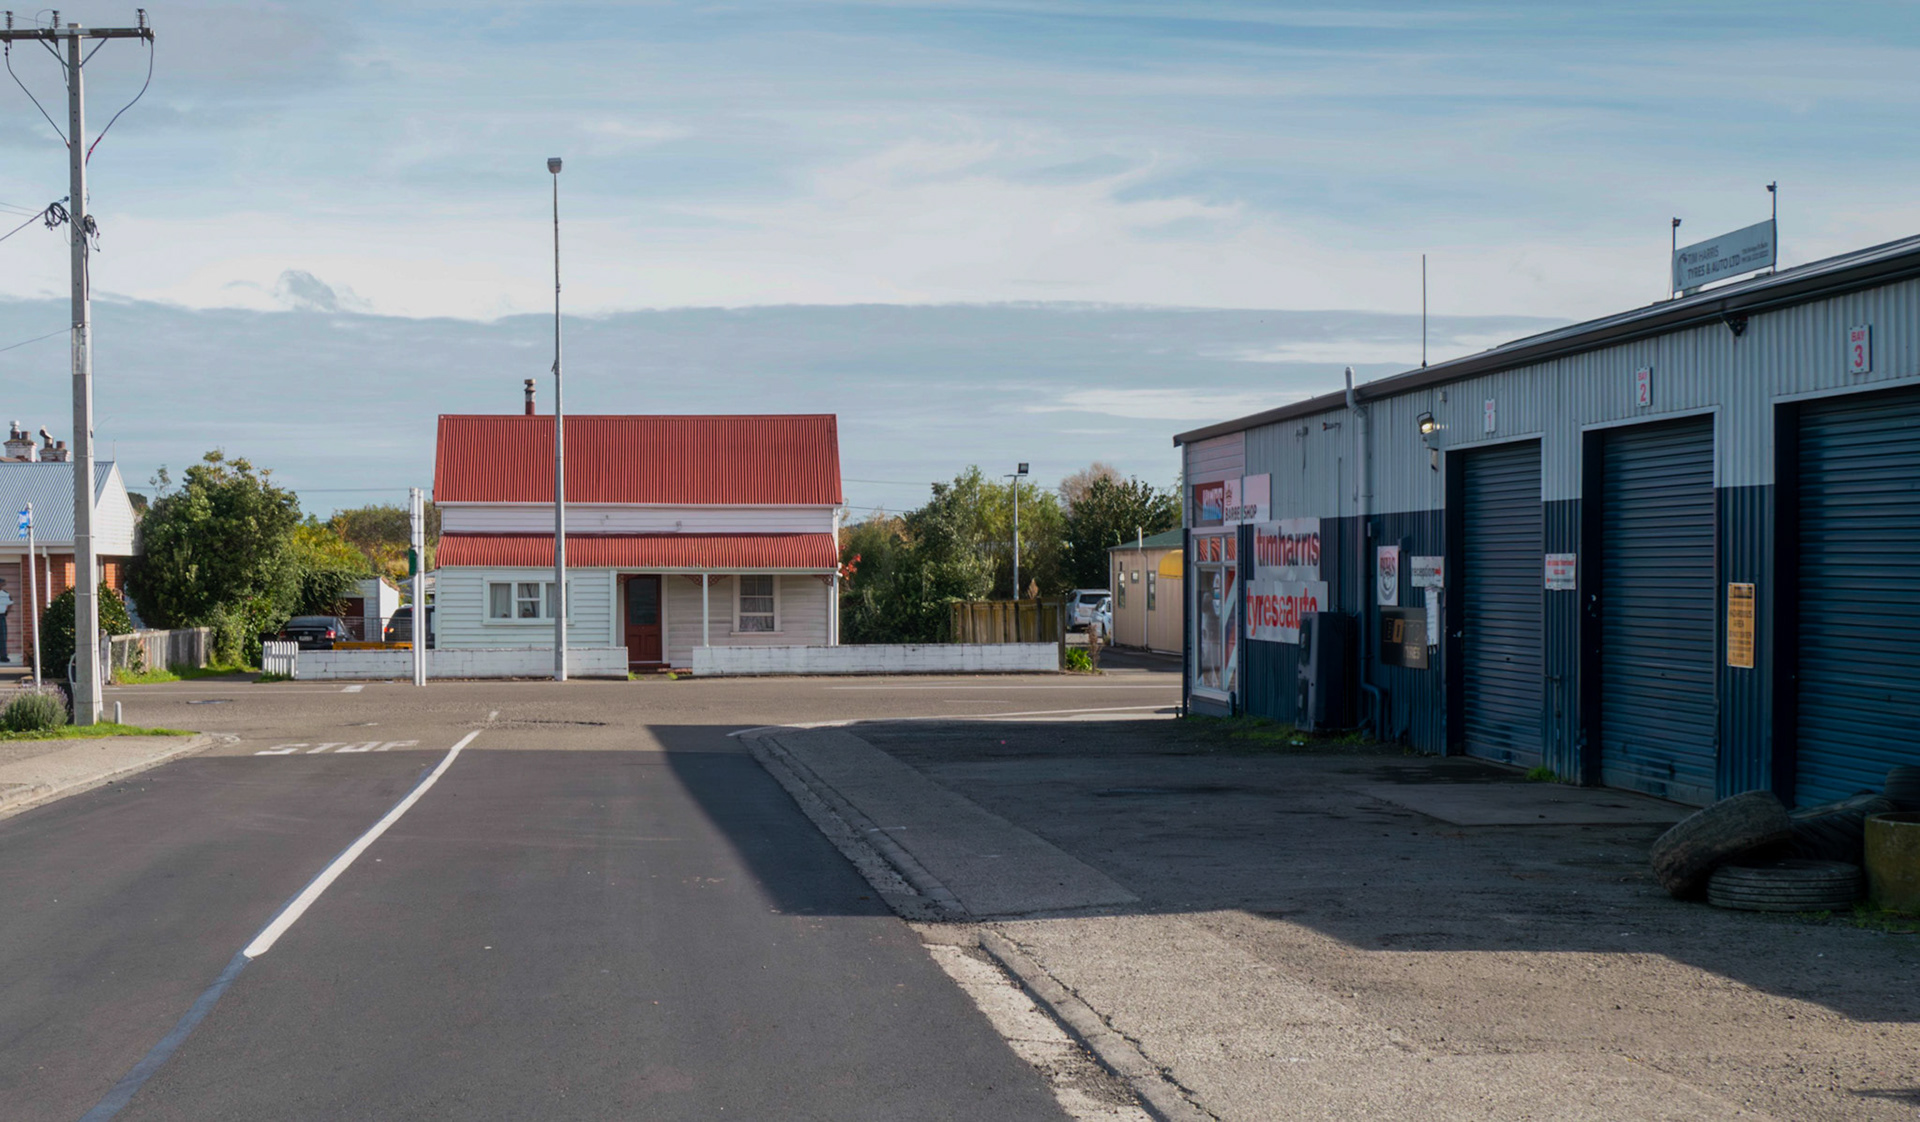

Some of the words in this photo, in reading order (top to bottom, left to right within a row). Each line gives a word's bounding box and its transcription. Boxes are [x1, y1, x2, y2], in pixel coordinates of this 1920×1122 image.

[1698, 245, 1719, 262] HARRIS
[1687, 264, 1706, 280] TYRES
[1711, 258, 1729, 273] AUTO
[1729, 254, 1740, 269] LTD
[1851, 330, 1865, 342] BAY
[1854, 344, 1864, 368] 3
[1640, 382, 1647, 402] 2
[1225, 505, 1243, 521] BARBE
[1243, 503, 1257, 520] SHOP
[1257, 526, 1320, 567] timharris
[254, 740, 420, 756] STOP
